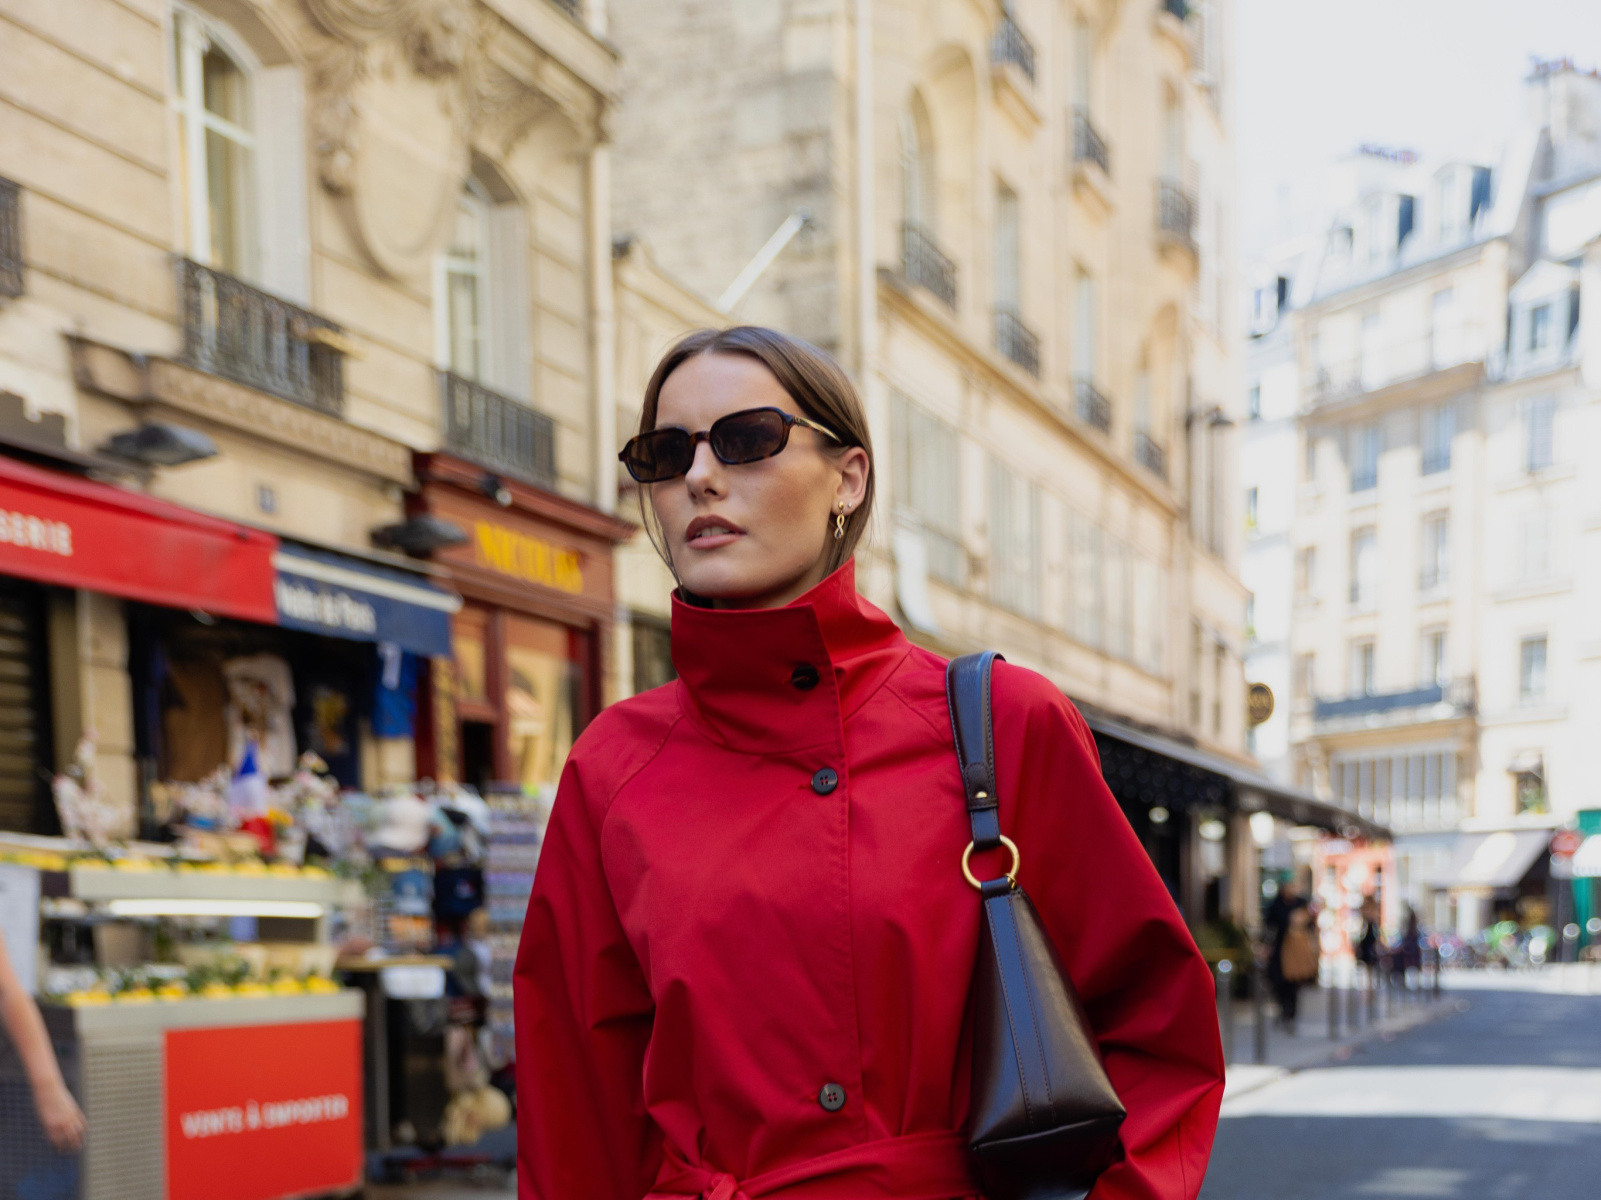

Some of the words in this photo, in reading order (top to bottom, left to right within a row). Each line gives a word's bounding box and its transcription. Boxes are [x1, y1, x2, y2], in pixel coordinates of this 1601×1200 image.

[180, 1106, 243, 1139] VENTE
[246, 1099, 261, 1131] À
[261, 1093, 349, 1129] EMPORTER
